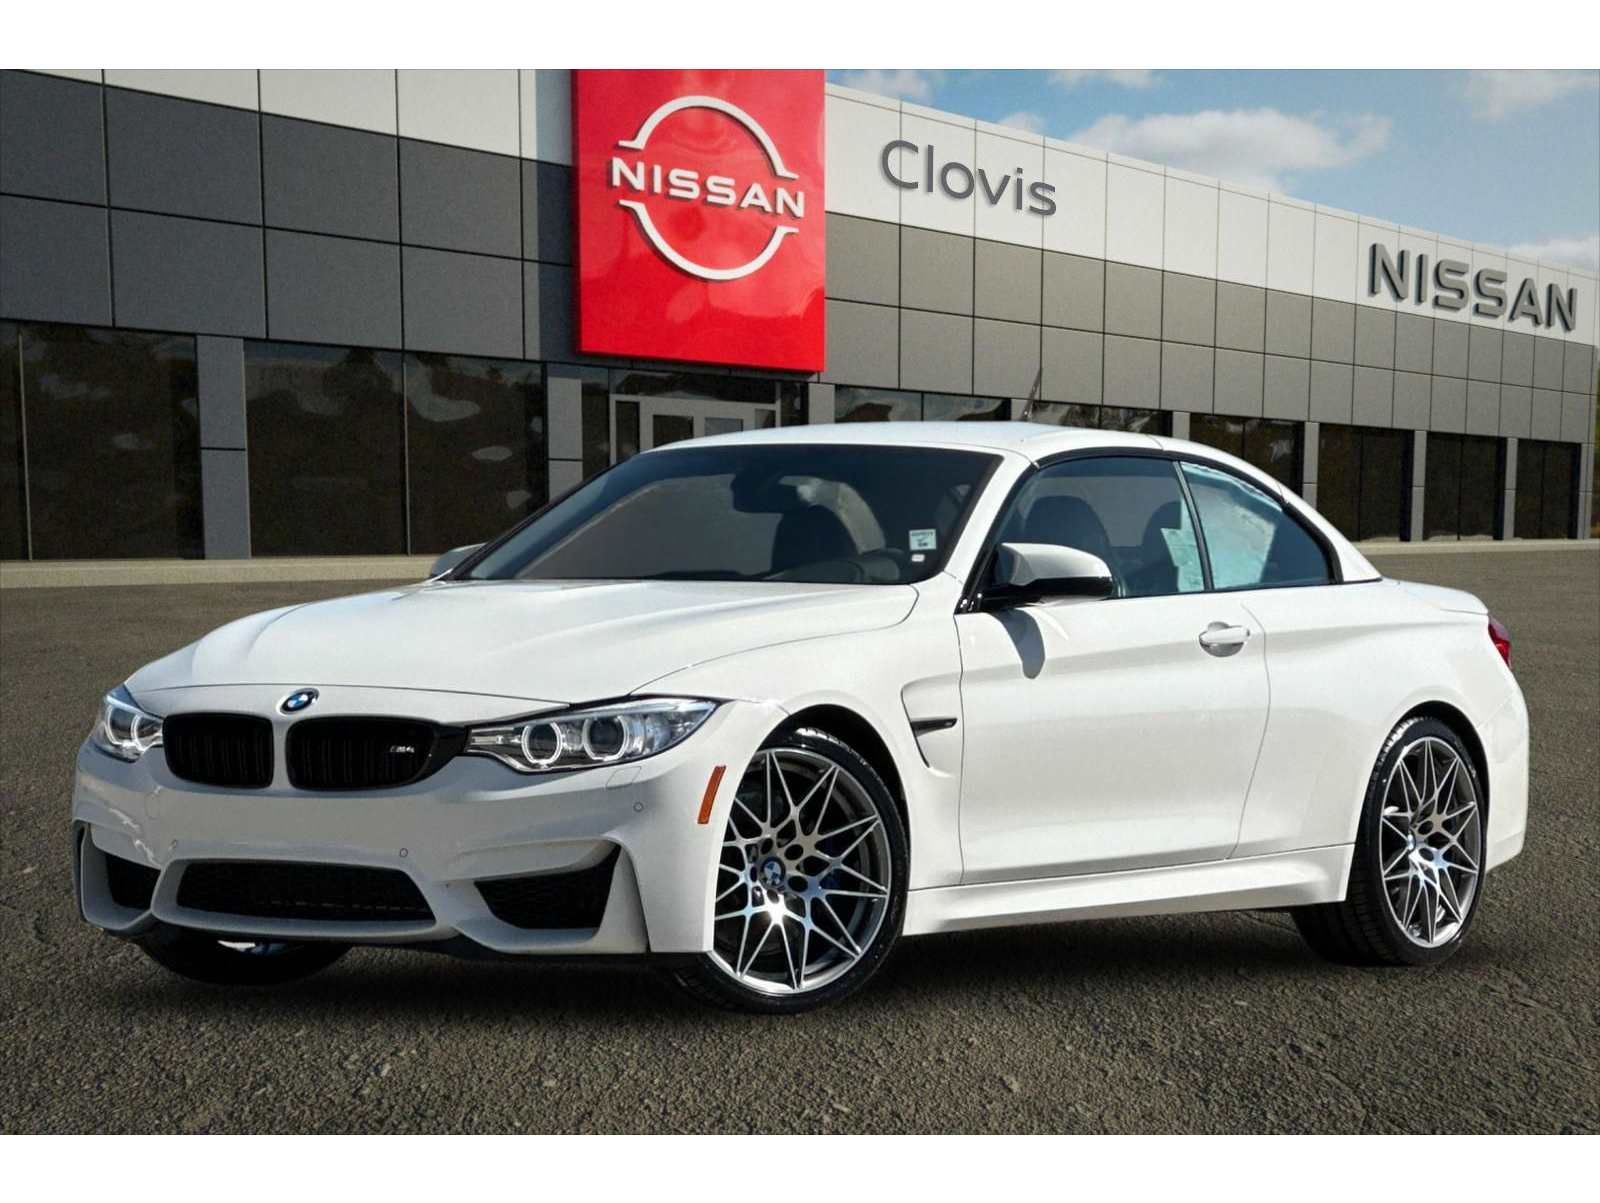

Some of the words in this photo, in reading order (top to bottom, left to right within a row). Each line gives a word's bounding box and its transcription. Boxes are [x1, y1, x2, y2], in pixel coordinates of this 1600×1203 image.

[611, 156, 805, 217] NISSAN
[881, 140, 1057, 216] Clovis
[1369, 243, 1578, 332] NISSAN
